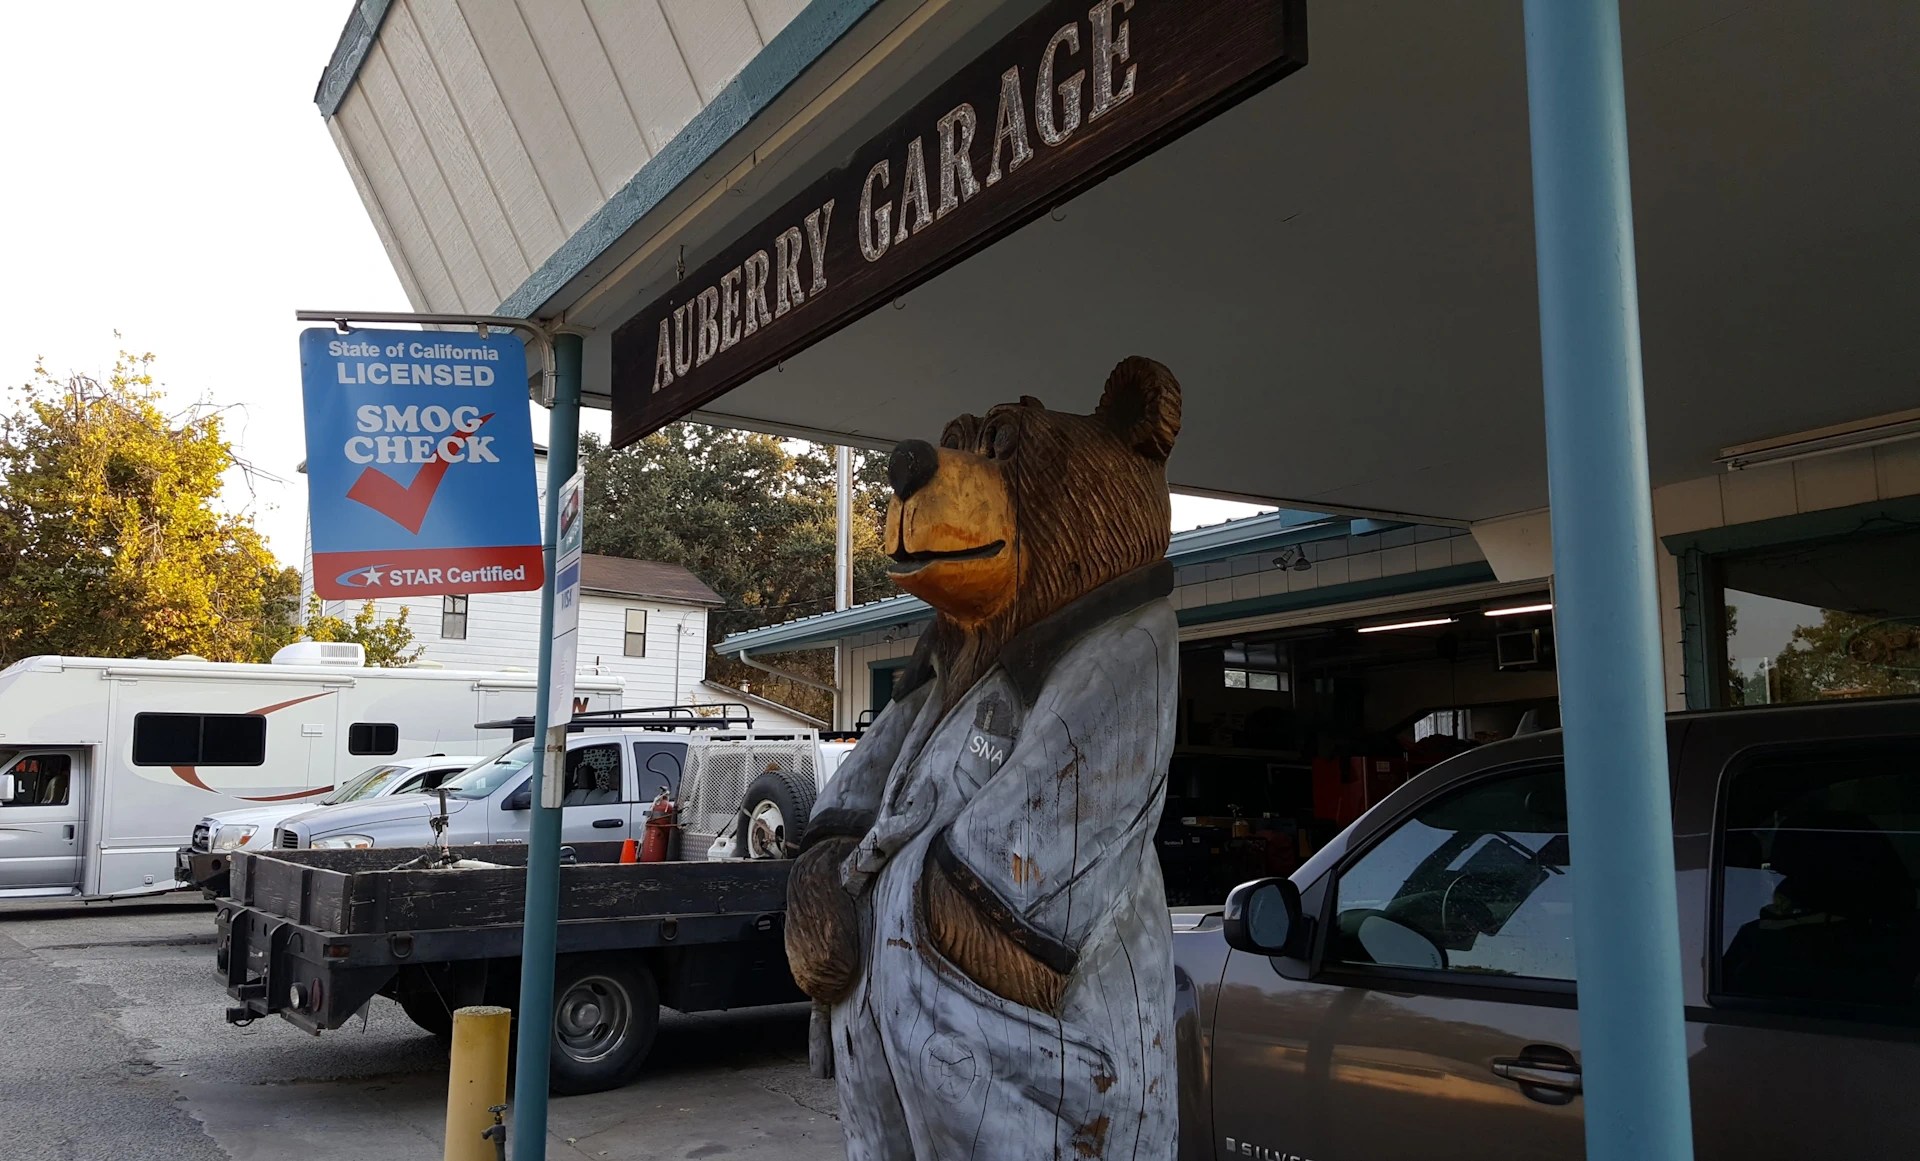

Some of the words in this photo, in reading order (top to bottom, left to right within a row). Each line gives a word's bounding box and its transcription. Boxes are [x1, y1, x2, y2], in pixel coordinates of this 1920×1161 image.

[652, 198, 835, 394] AUBERRY
[858, 0, 1138, 263] GARAGE
[328, 341, 380, 358] State
[385, 342, 404, 358] of
[409, 343, 499, 361] California
[337, 362, 495, 387] LICENSED
[356, 405, 483, 433] SMOG
[344, 436, 500, 464] CHECK
[389, 567, 442, 586] STAR
[446, 565, 525, 584] Certified
[1241, 1142, 1314, 1161] SILV
